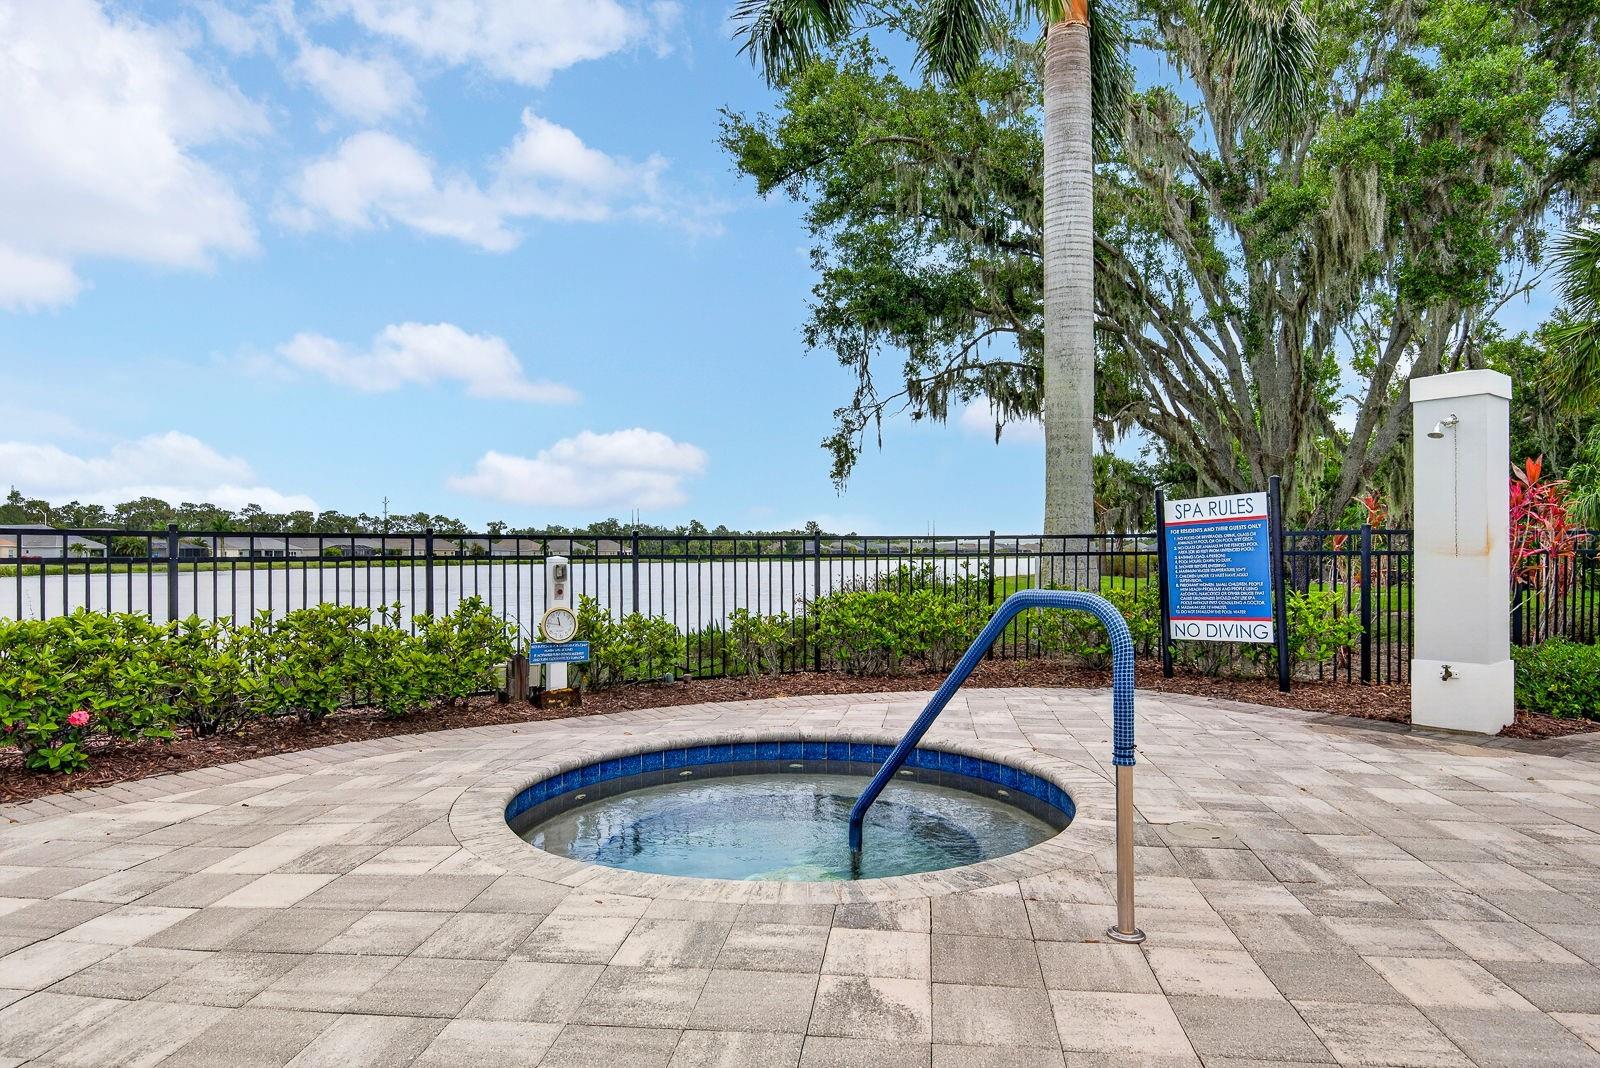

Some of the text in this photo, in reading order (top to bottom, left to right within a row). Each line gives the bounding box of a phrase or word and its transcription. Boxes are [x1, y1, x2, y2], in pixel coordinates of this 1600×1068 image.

[1175, 497, 1254, 520] SPA RULES
[1175, 623, 1269, 640] NO DIVING
